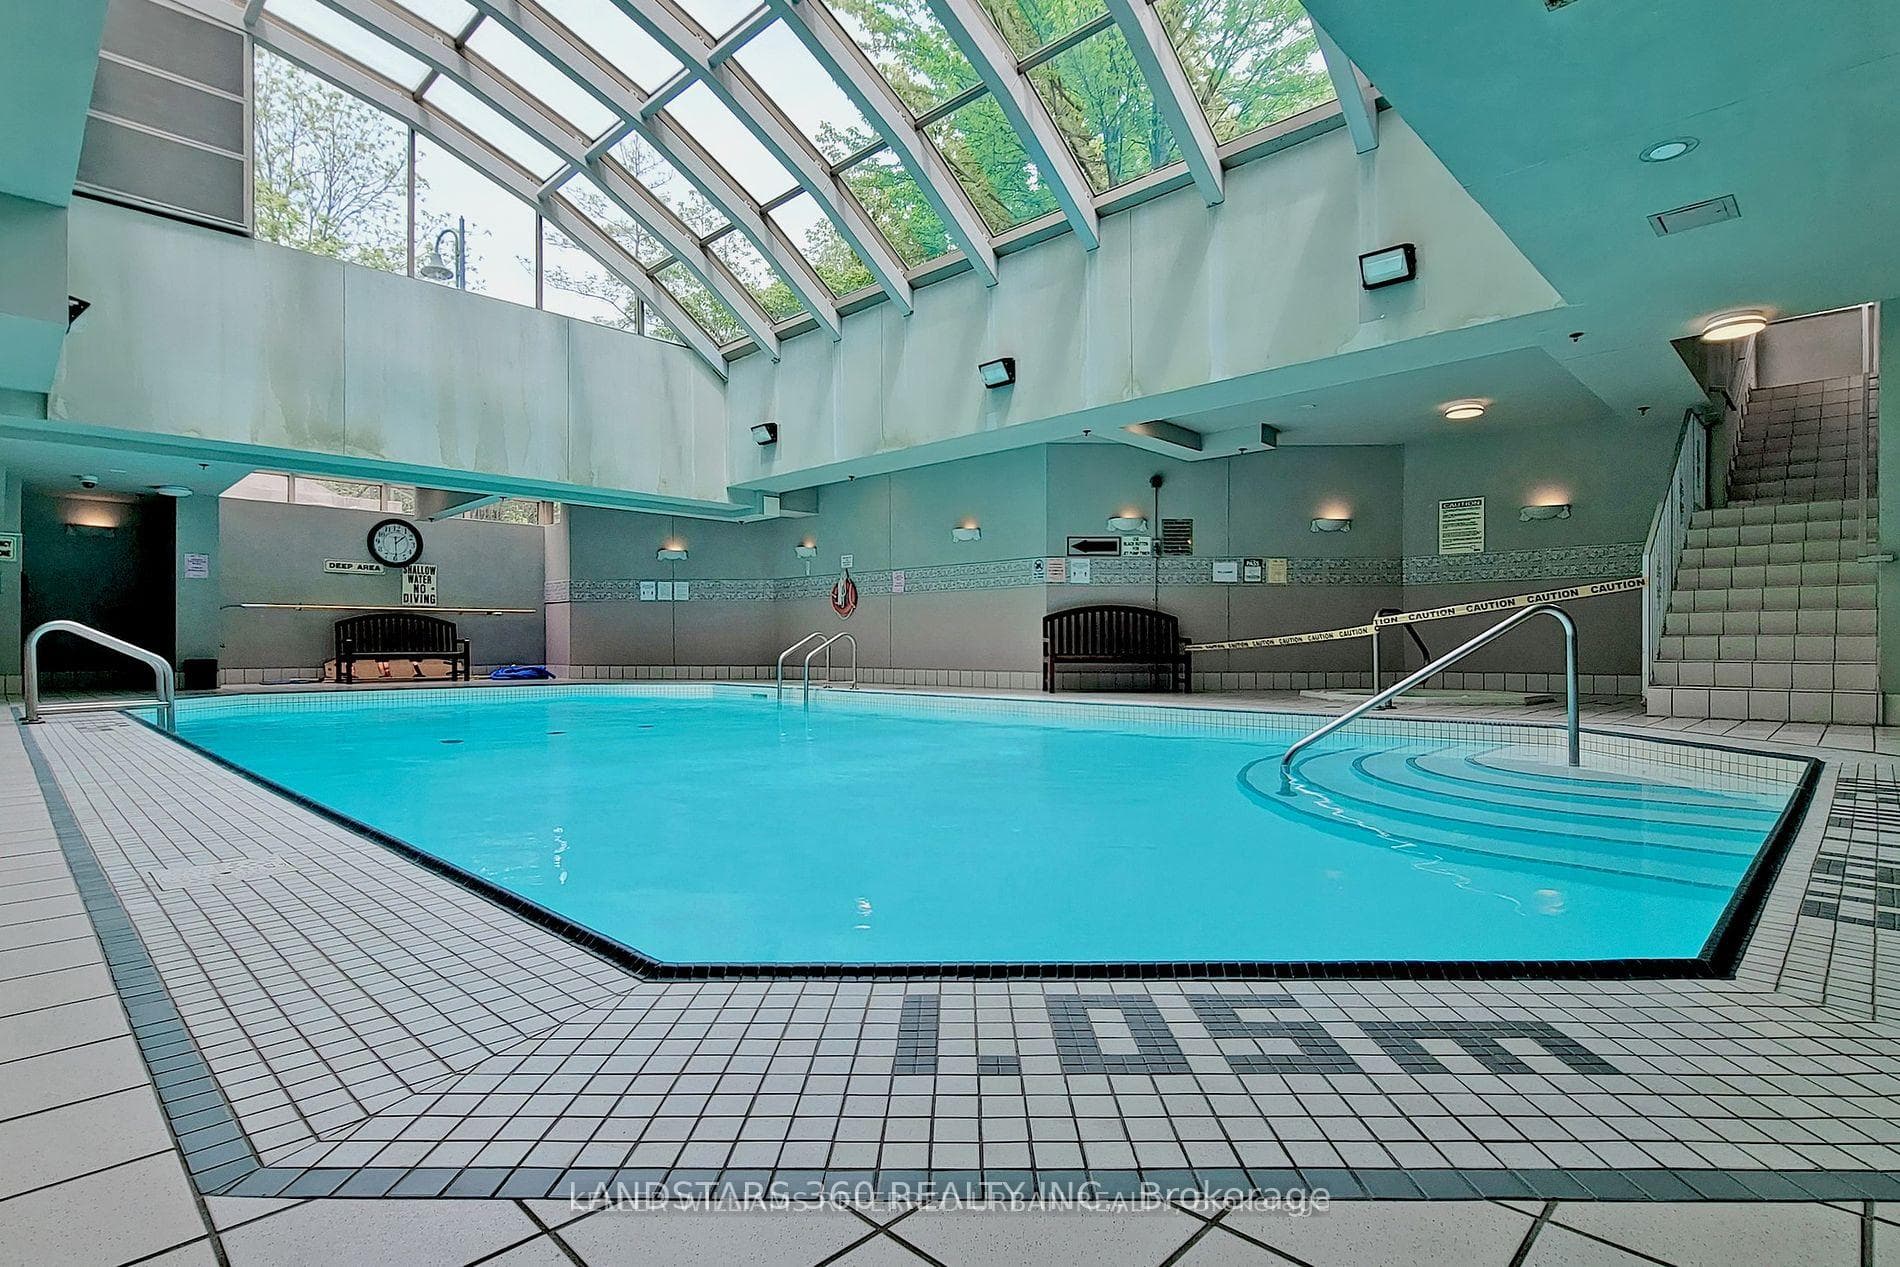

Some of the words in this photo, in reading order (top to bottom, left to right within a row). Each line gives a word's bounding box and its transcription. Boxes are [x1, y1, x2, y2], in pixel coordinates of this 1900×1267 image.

[1443, 500, 1480, 508] CAUTION
[329, 562, 353, 570] DEEP
[403, 566, 437, 576] SHALLOW
[408, 575, 432, 584] WATER
[414, 584, 426, 594] NO
[403, 593, 436, 604] DIVING
[1374, 616, 1398, 625] TION
[1408, 607, 1455, 621] CAUTION
[1466, 598, 1516, 613] CAUTION
[1527, 588, 1579, 603] CAUTION
[1591, 578, 1645, 594] CAUTION
[1279, 635, 1303, 645] CAUTION
[1307, 632, 1334, 642] CAUTION
[1339, 626, 1368, 638] CAUTION
